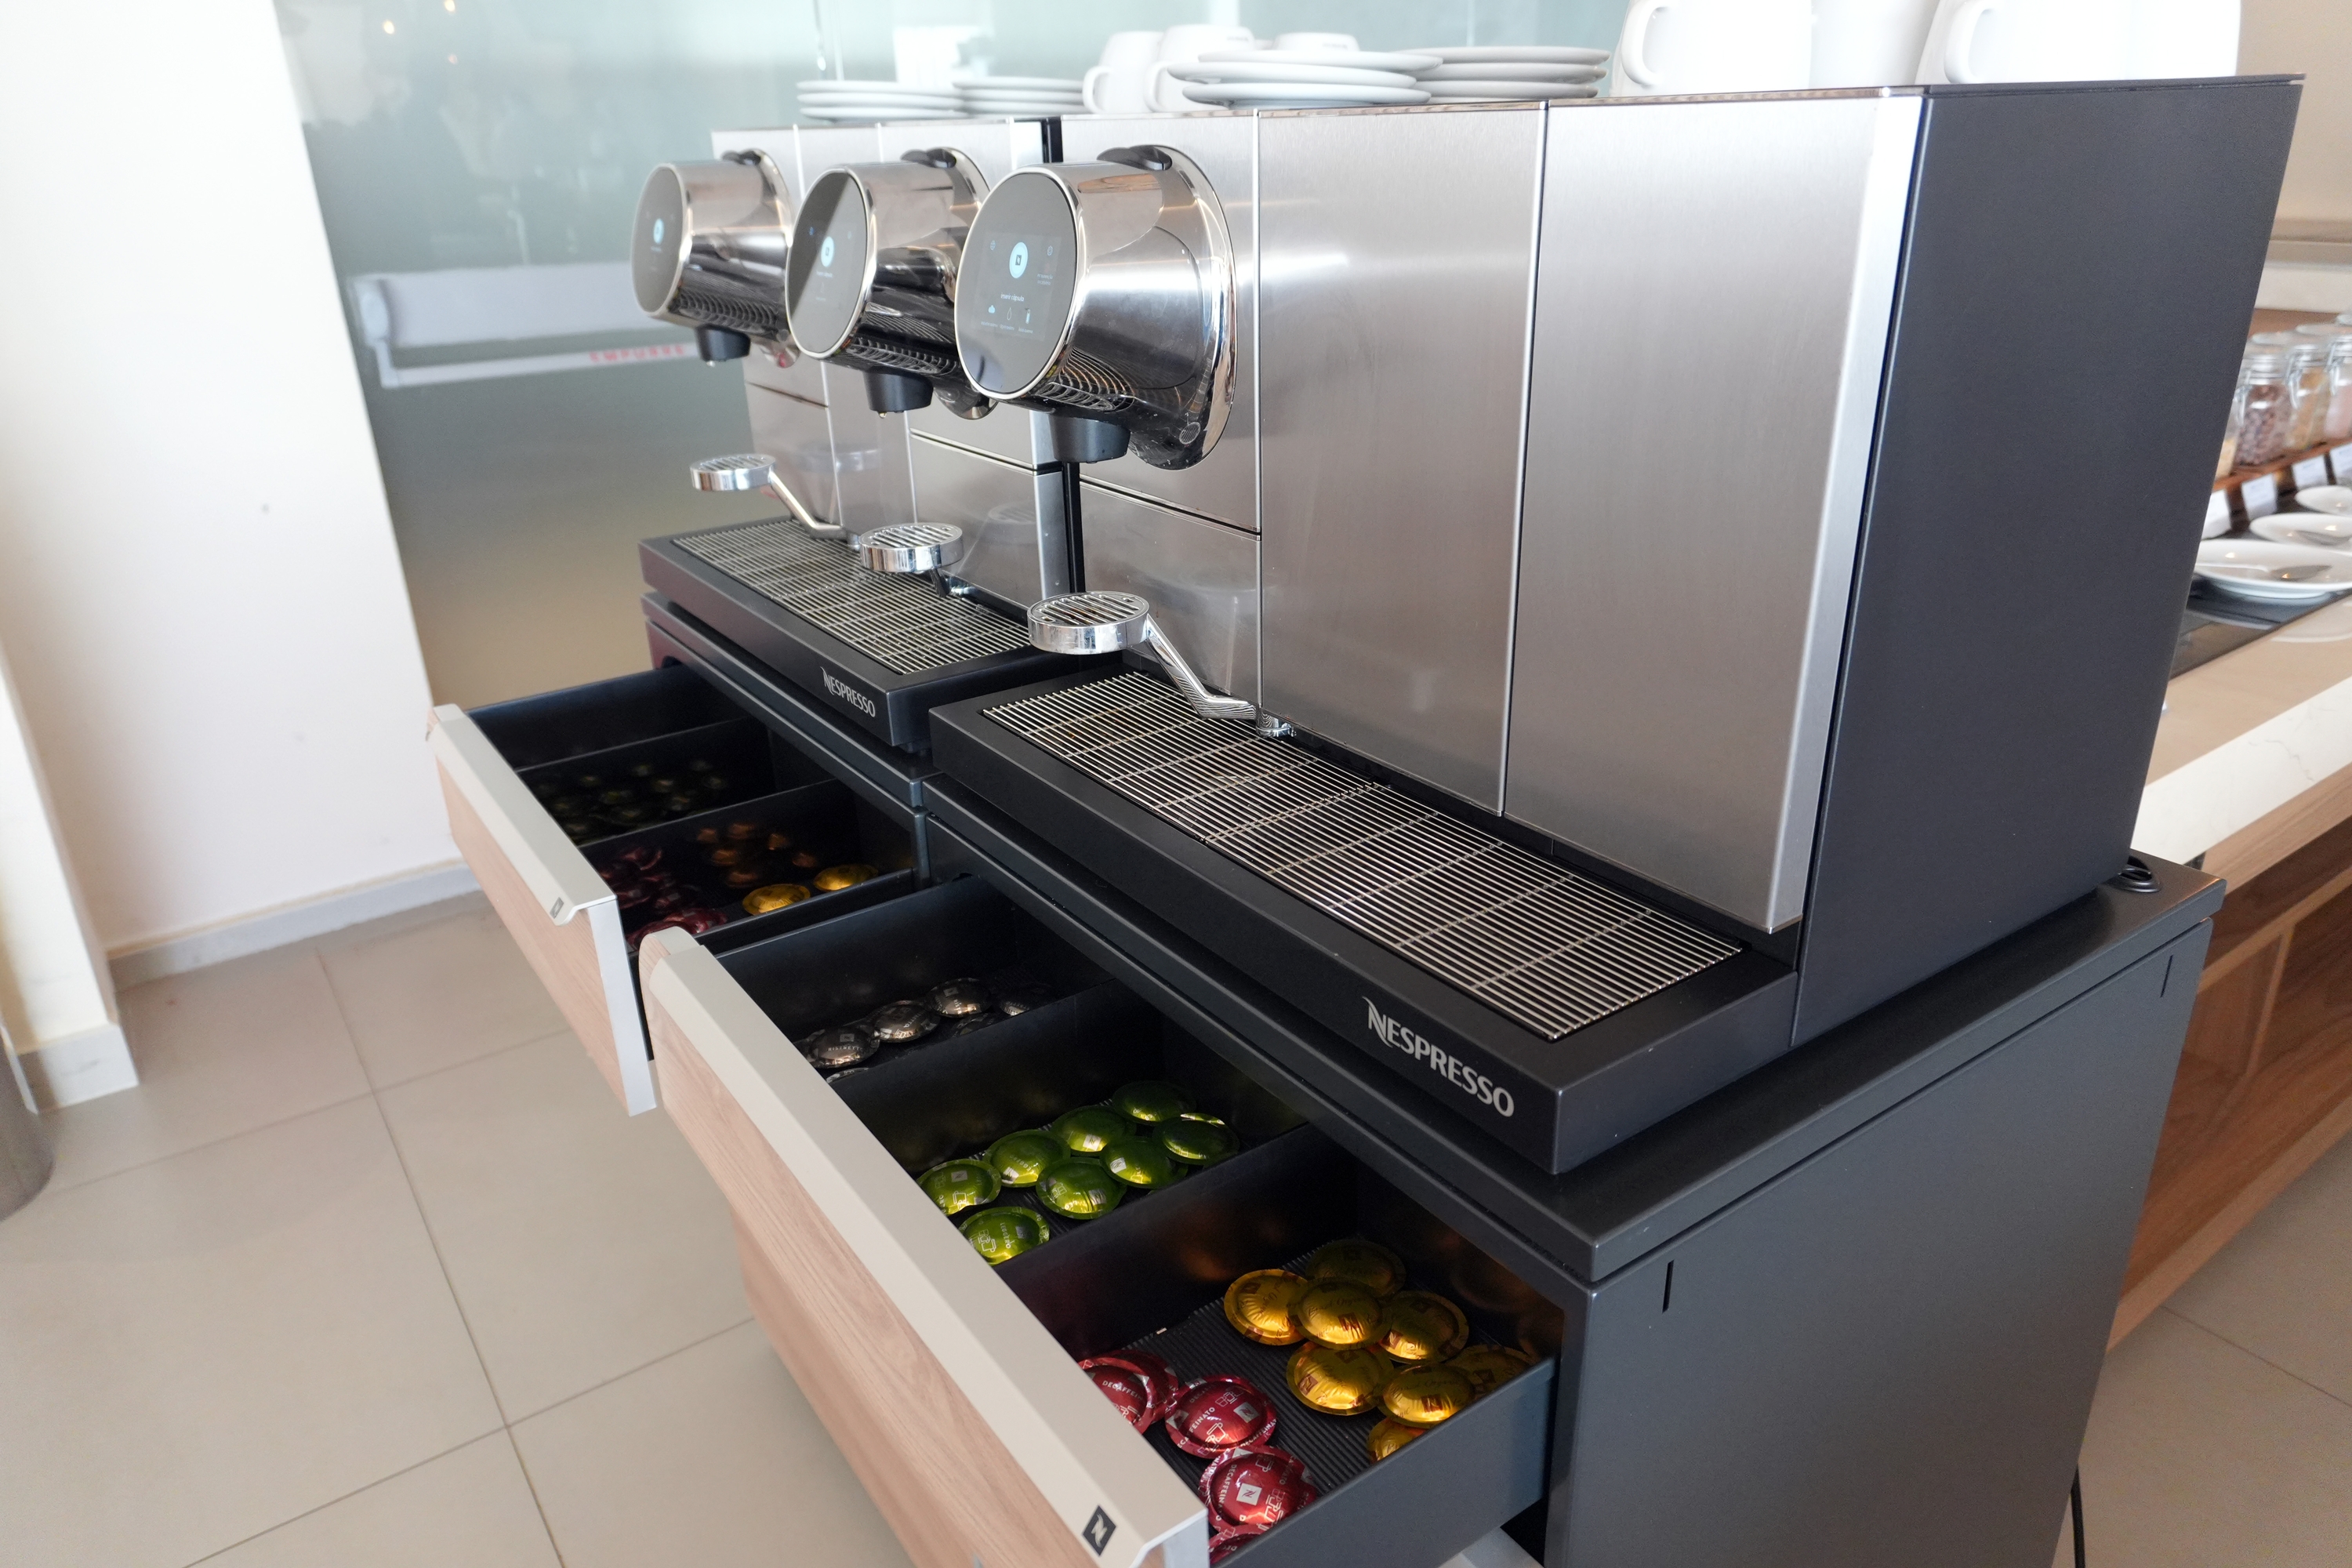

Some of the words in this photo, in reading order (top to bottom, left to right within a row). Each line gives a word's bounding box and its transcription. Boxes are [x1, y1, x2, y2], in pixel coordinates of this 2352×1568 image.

[820, 666, 876, 717] NESPRESSO
[1362, 996, 1515, 1117] NESPRESSO
[1000, 1222, 1011, 1249] LEGGERO
[1102, 1380, 1144, 1401] DECAFFEIN
[1177, 1406, 1215, 1449] ECAFEINATO
